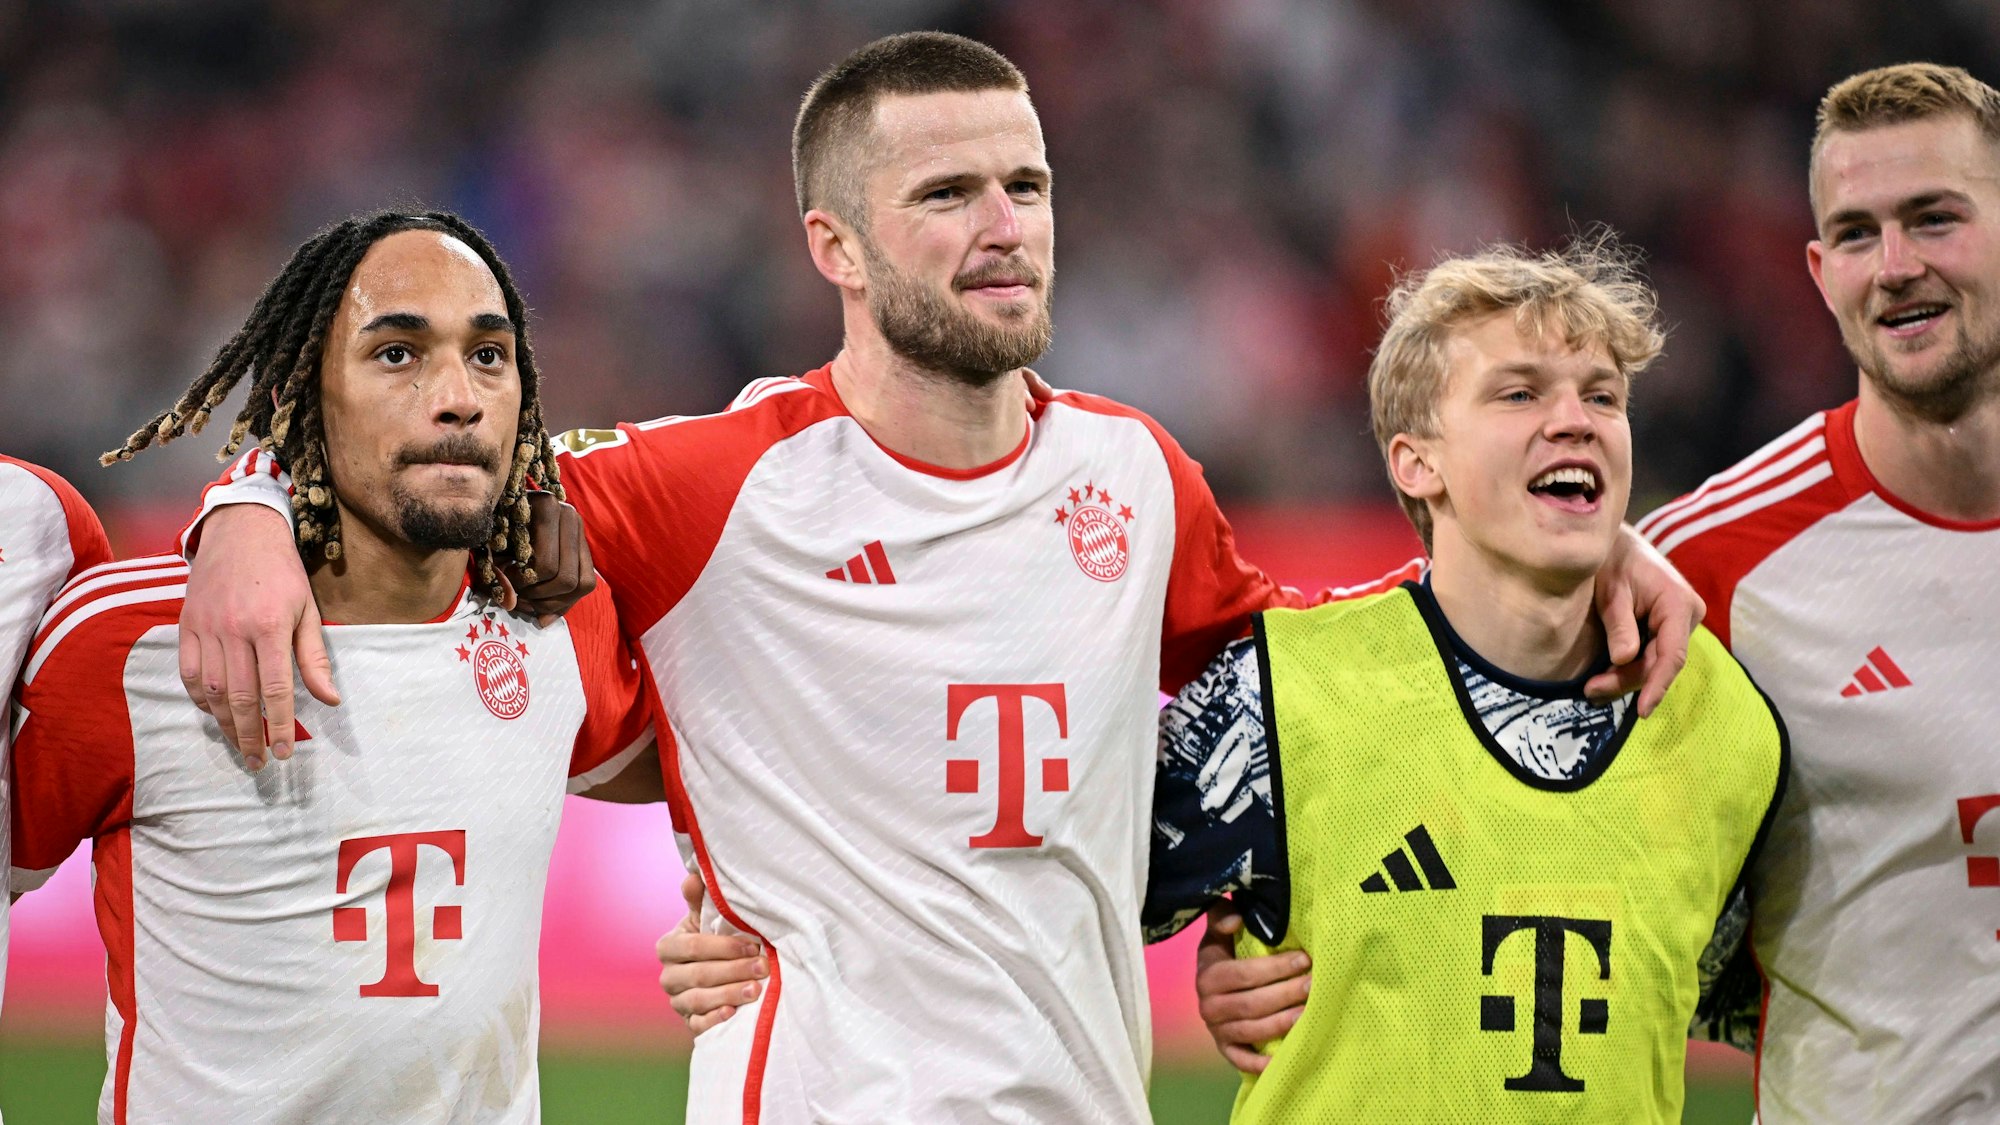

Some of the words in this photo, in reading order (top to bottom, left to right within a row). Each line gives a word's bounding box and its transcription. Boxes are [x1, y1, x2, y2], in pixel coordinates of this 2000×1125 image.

[1073, 522, 1083, 539] FC
[1080, 510, 1122, 537] BAYERN
[479, 658, 487, 675] FC
[483, 645, 521, 673] BAYERN
[946, 683, 1069, 848] T
[333, 830, 466, 997] T
[1481, 915, 1612, 1092] T
